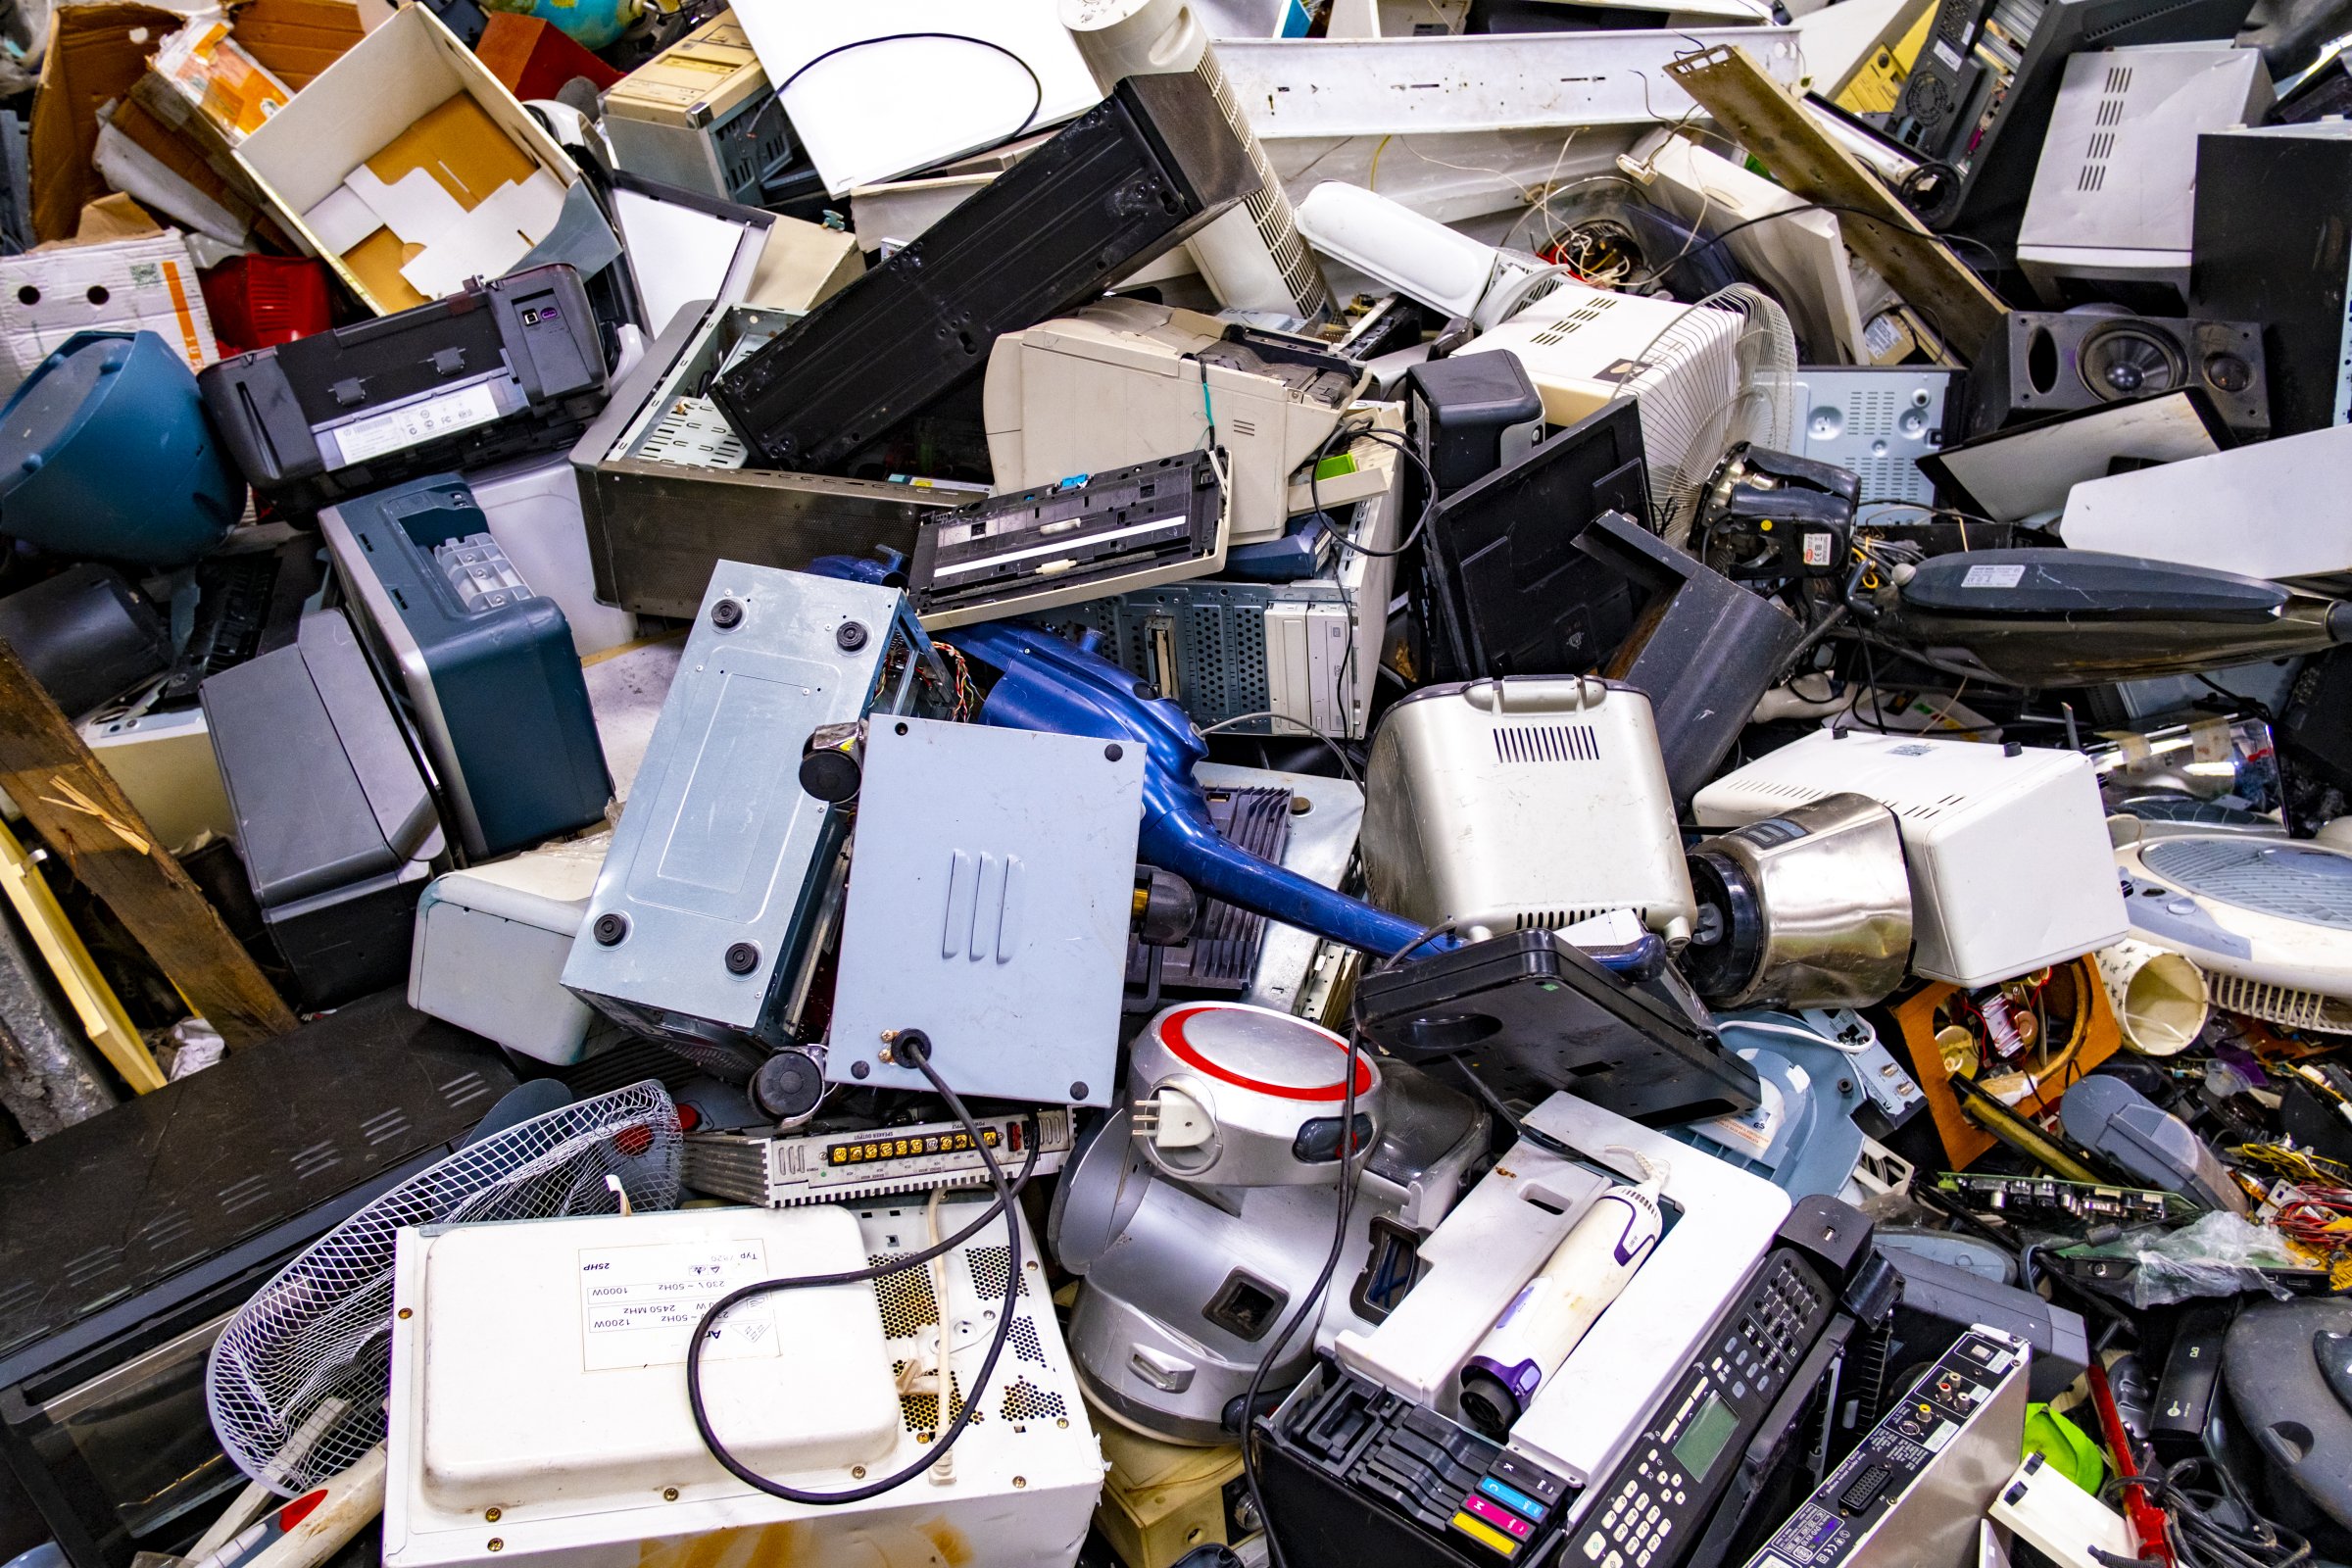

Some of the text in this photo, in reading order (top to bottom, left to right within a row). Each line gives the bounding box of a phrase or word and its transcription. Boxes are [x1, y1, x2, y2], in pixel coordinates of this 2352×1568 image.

[740, 1252, 757, 1260] Typ
[592, 1287, 628, 1296] 1000W
[624, 1306, 647, 1314] MHz
[650, 1304, 675, 1313] 2450
[595, 1318, 630, 1328] 1200W
[1503, 1462, 1514, 1473] K
[1488, 1482, 1499, 1493] C
[1473, 1500, 1486, 1512] M
